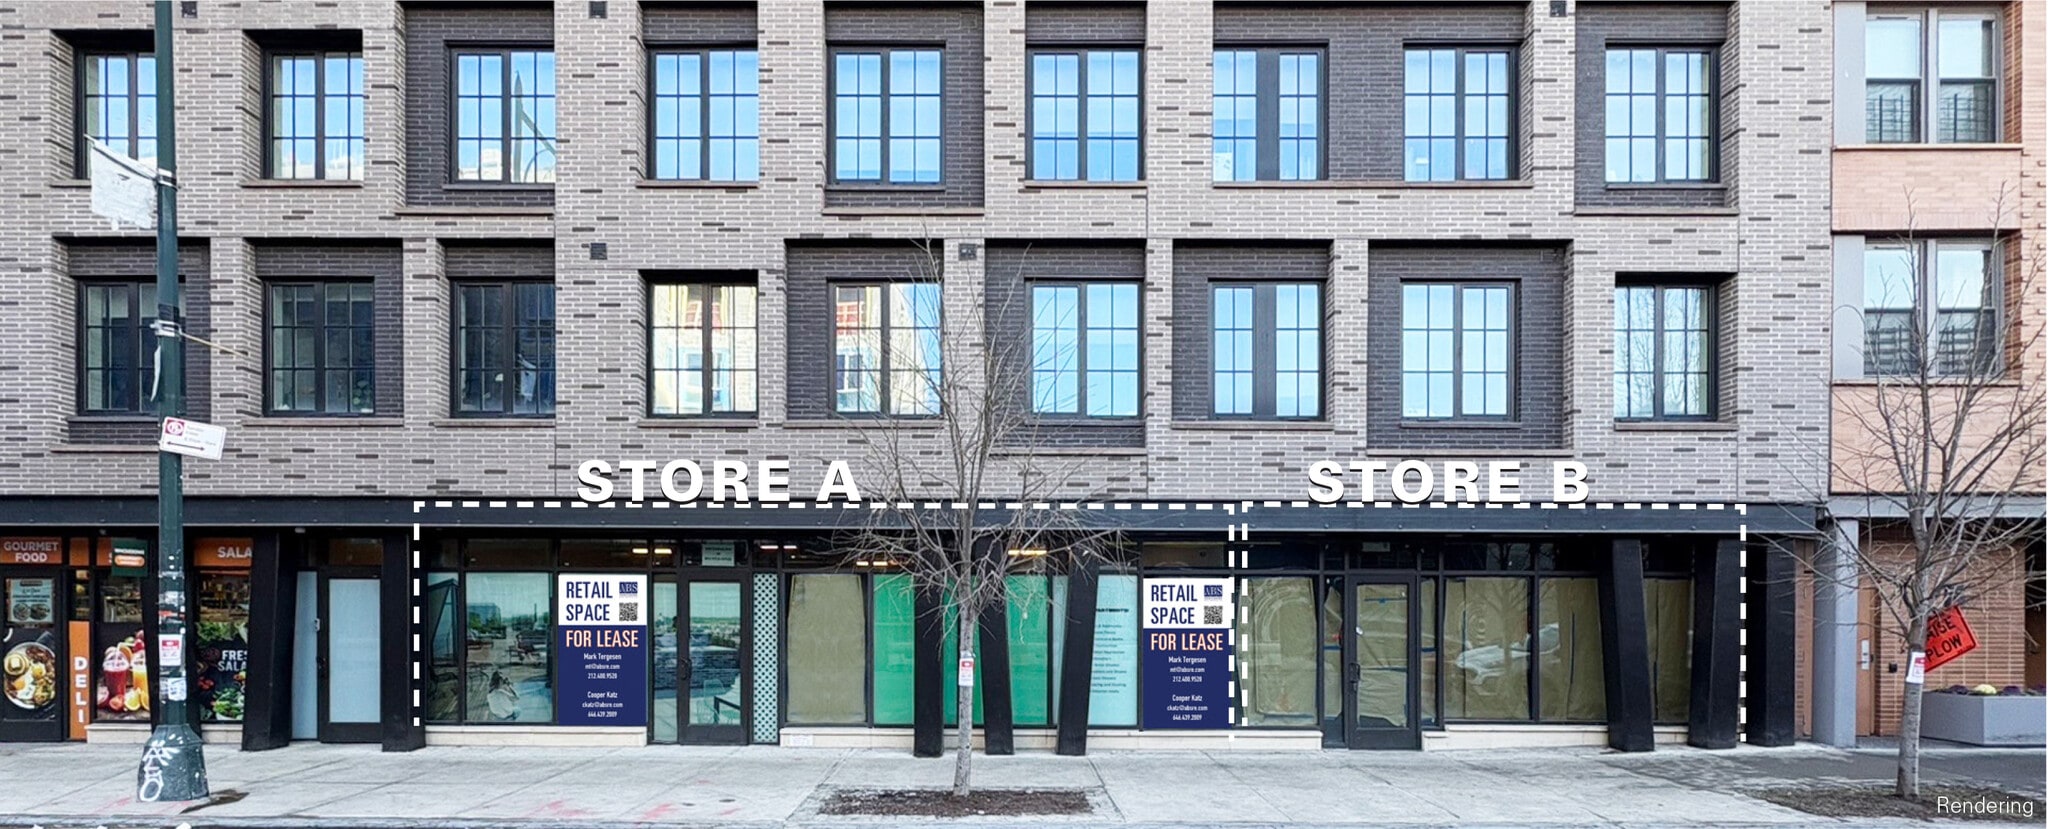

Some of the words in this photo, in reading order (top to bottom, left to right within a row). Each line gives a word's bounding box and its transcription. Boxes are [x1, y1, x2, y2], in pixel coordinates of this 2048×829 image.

[3, 541, 59, 552] GOURMET
[15, 552, 48, 563] FOOD
[566, 581, 613, 598] RETAIL
[1151, 584, 1198, 601] RETAIL
[566, 604, 610, 621] SPACE
[1151, 607, 1195, 624] SPACE
[566, 630, 592, 648] FOR
[597, 630, 639, 648] LEASE
[1151, 633, 1177, 651] FOR
[1182, 633, 1224, 651] LEASE
[1926, 633, 1962, 662] PLOW
[583, 652, 597, 660] Mark
[1168, 655, 1182, 663] Mark
[74, 656, 88, 722] DELI
[587, 691, 606, 700] Cooper
[606, 691, 618, 699] Katz
[1172, 694, 1191, 703] Cooper
[1191, 694, 1203, 702] Katz
